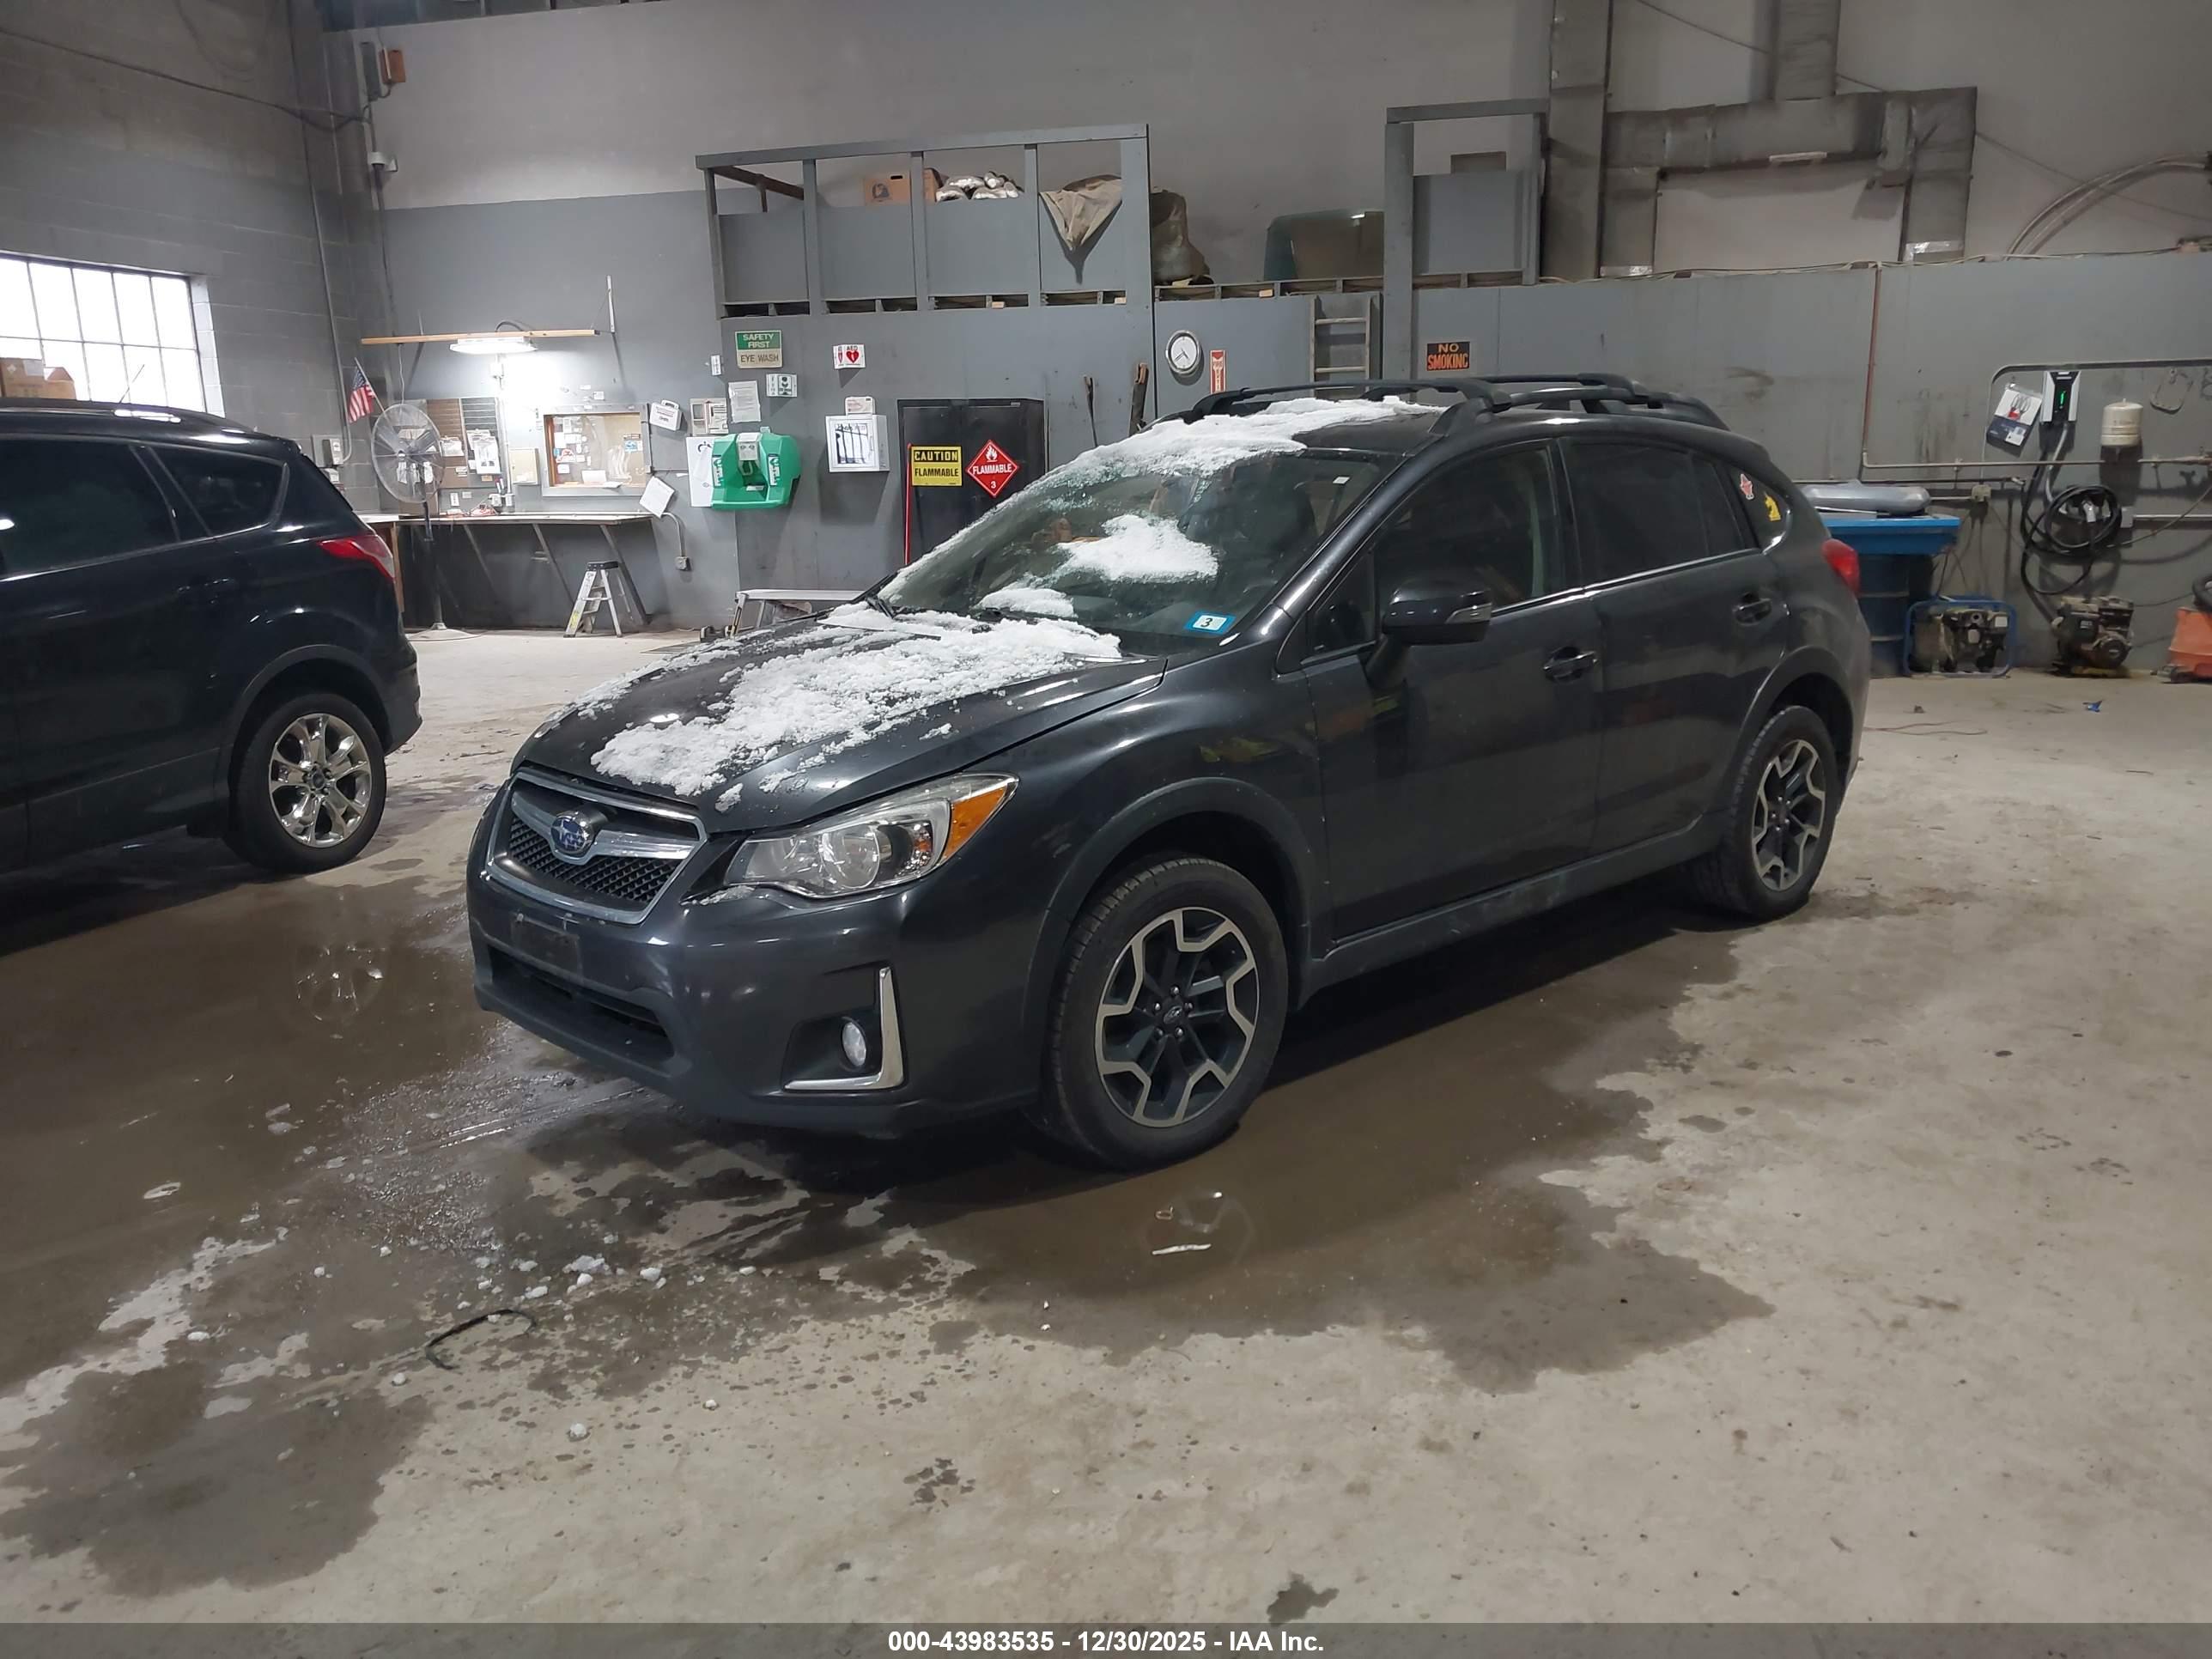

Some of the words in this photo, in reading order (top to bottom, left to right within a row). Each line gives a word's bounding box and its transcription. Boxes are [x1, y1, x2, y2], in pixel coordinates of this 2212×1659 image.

[1438, 343, 1459, 353] NO
[741, 355, 756, 363] EYE
[757, 353, 779, 362] WASH
[1428, 353, 1468, 369] SMOKING
[915, 451, 957, 461] CAUTION
[915, 468, 959, 477] FLAMMABLE
[972, 464, 1012, 475] FLAMMABLE
[991, 481, 997, 489] 3
[1200, 617, 1212, 627] 3
